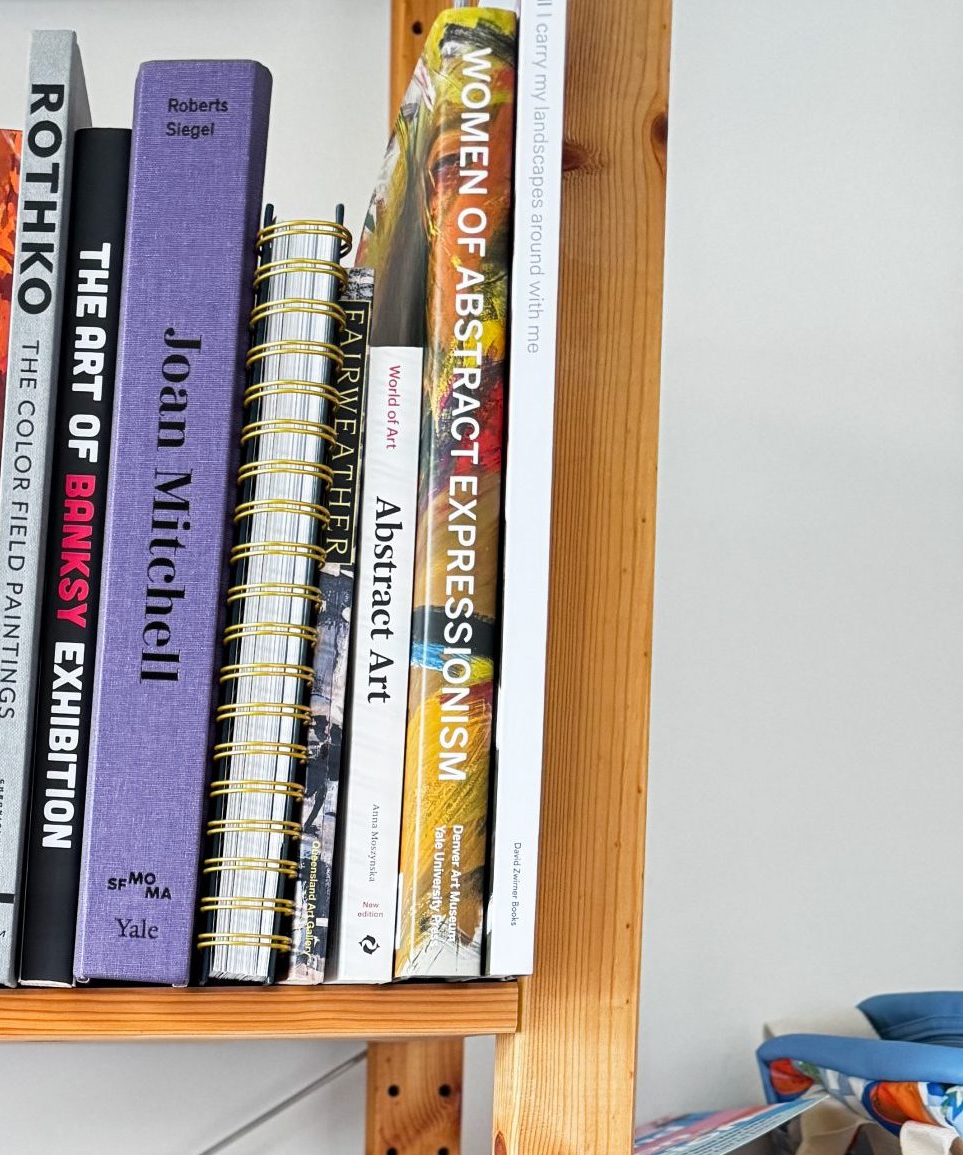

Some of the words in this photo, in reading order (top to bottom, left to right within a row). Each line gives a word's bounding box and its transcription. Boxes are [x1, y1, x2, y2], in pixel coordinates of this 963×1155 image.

[532, 23, 549, 69] carry
[167, 97, 229, 114] Roberts
[531, 73, 548, 101] my
[165, 121, 215, 139] Siegel
[458, 48, 493, 196] WOMEN
[528, 106, 550, 208] landscapes
[17, 83, 65, 315] ROTHKO
[456, 207, 487, 258] OF
[529, 213, 545, 276] around
[75, 242, 111, 319] THE
[528, 280, 545, 319] with
[19, 340, 40, 389] THE
[70, 325, 108, 402] ART
[450, 264, 486, 465] ABSTRACT
[527, 325, 540, 353] me
[156, 327, 203, 453] Joan
[387, 364, 401, 407] World
[67, 413, 101, 463] OF
[325, 308, 366, 555] FAIRWEATHER
[385, 429, 397, 450] Art
[387, 411, 400, 427] of
[12, 400, 36, 492] COLOR
[8, 501, 30, 571] FIELD
[56, 473, 97, 629] BANKSY
[139, 467, 194, 685] Mitchell
[370, 496, 403, 640] Abstract
[438, 475, 478, 782] EXPRESSIONISM
[367, 650, 395, 704] Art
[41, 641, 86, 849] EXHIBITION
[370, 803, 381, 829] Anna
[434, 825, 446, 849] Yale
[308, 841, 321, 900] Queensland
[367, 830, 380, 882] Moszynska
[450, 824, 463, 866] Denver
[512, 842, 522, 866] David
[429, 851, 445, 912] University
[449, 871, 461, 888] Art
[511, 868, 521, 899] Zwirner
[115, 918, 159, 940] Yale
[306, 903, 317, 918] Art
[447, 891, 461, 943] Museum
[510, 901, 520, 926] Books
